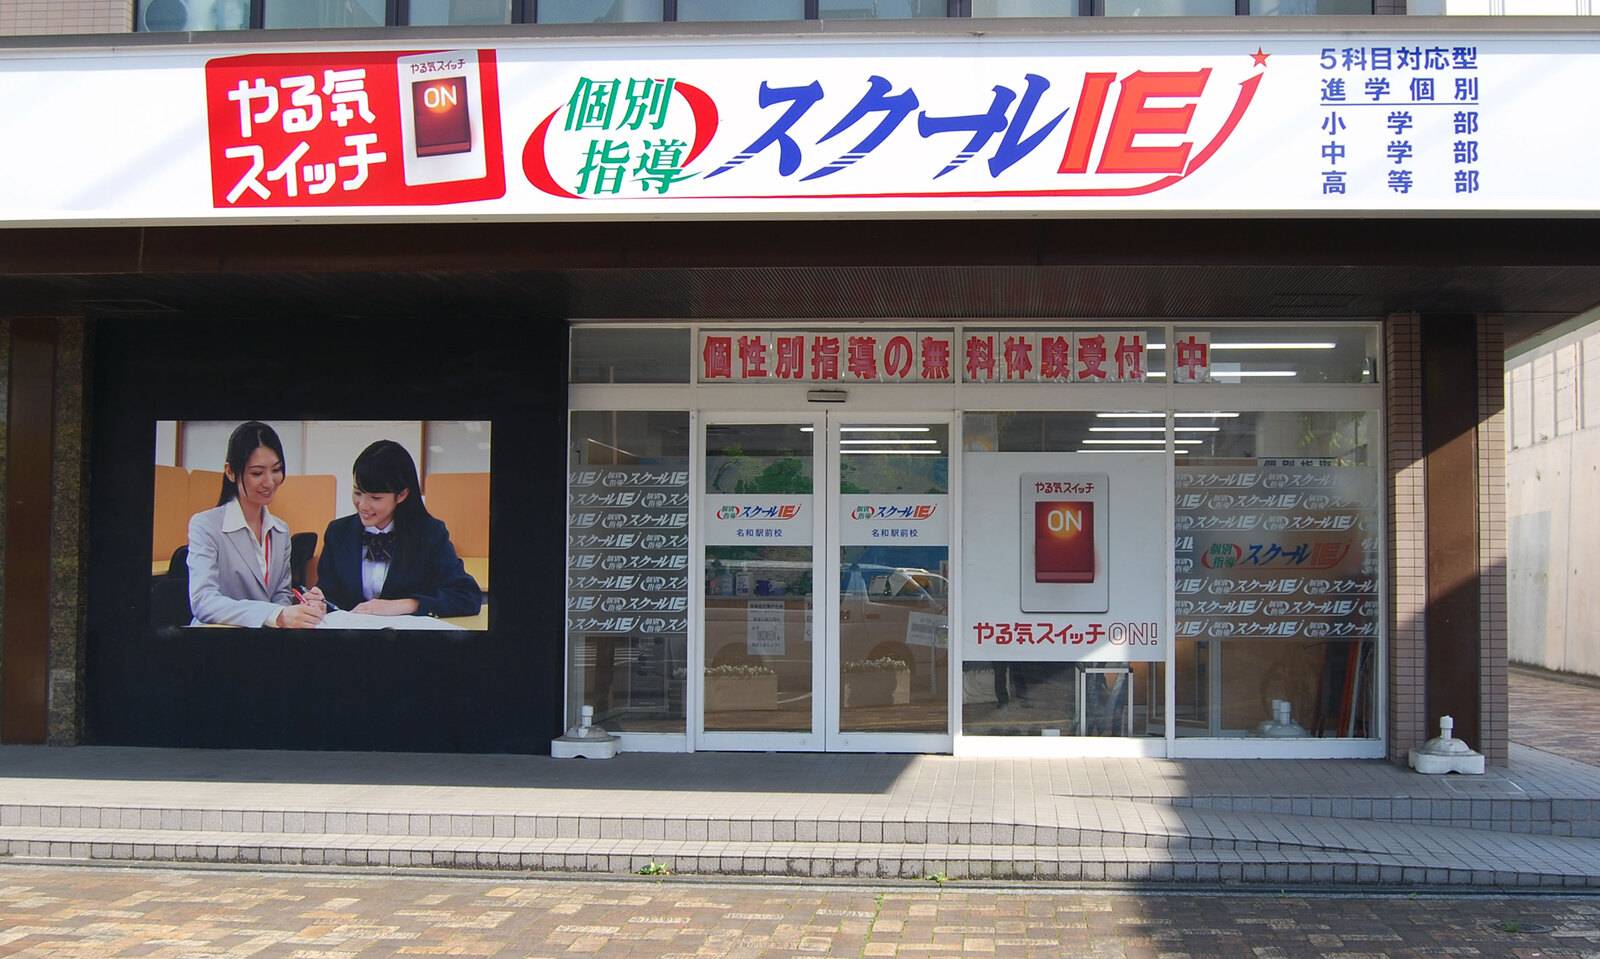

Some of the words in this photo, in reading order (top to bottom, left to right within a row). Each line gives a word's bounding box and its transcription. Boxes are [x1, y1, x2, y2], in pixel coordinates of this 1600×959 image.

[410, 58, 466, 74] やる気スイッチ
[424, 85, 458, 108] ON
[1320, 77, 1479, 101] 進学個別
[228, 69, 376, 138] やる気
[564, 76, 677, 132] 個別
[225, 132, 387, 204] スイッチ
[575, 138, 692, 195] 指導
[1035, 482, 1095, 494] やる気スイッチ
[1047, 510, 1083, 532] ON
